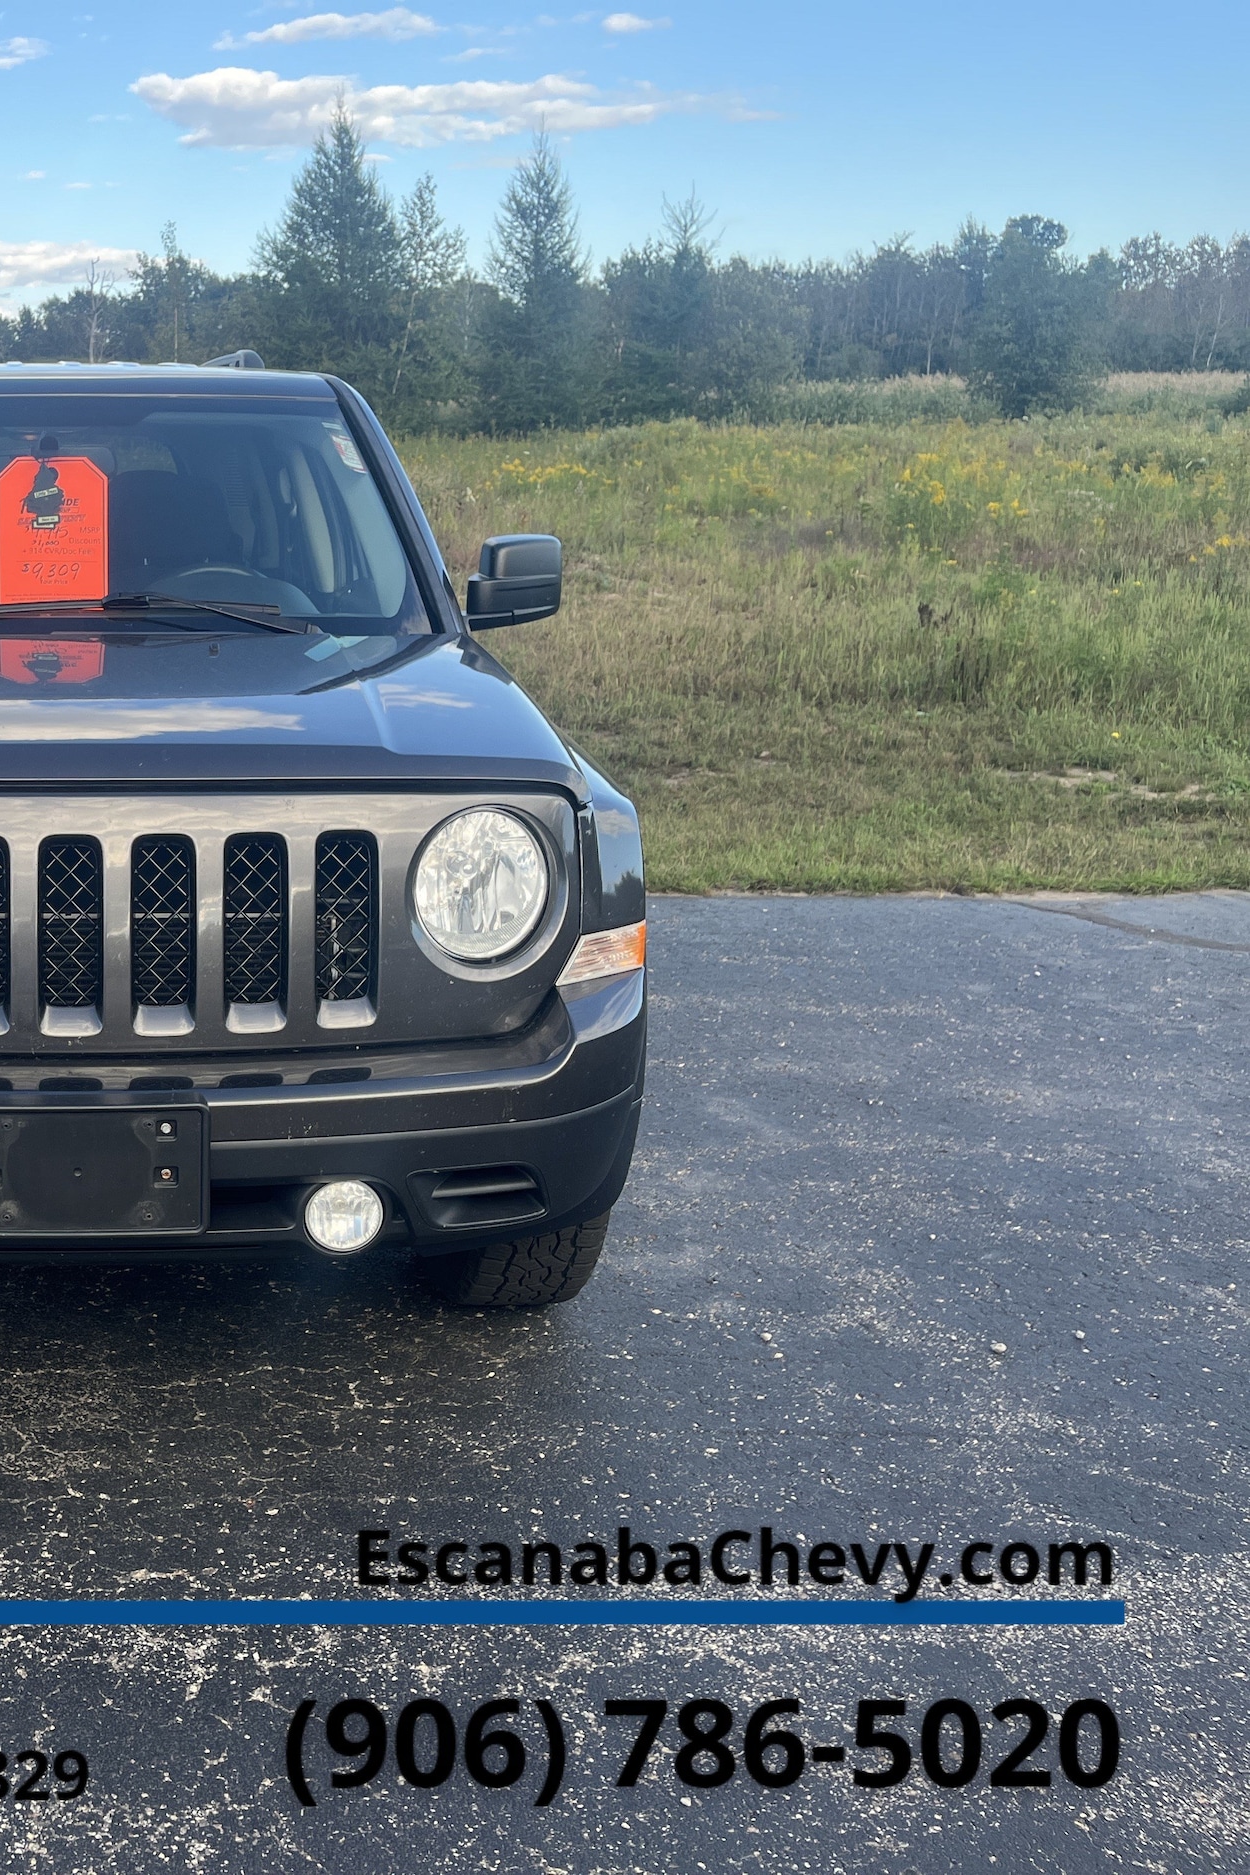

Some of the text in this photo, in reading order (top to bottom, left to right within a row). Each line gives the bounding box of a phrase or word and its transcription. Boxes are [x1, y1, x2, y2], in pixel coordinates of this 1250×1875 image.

[79, 526, 101, 534] MSRP
[68, 537, 101, 545] Discount
[21, 562, 80, 580] $9,309
